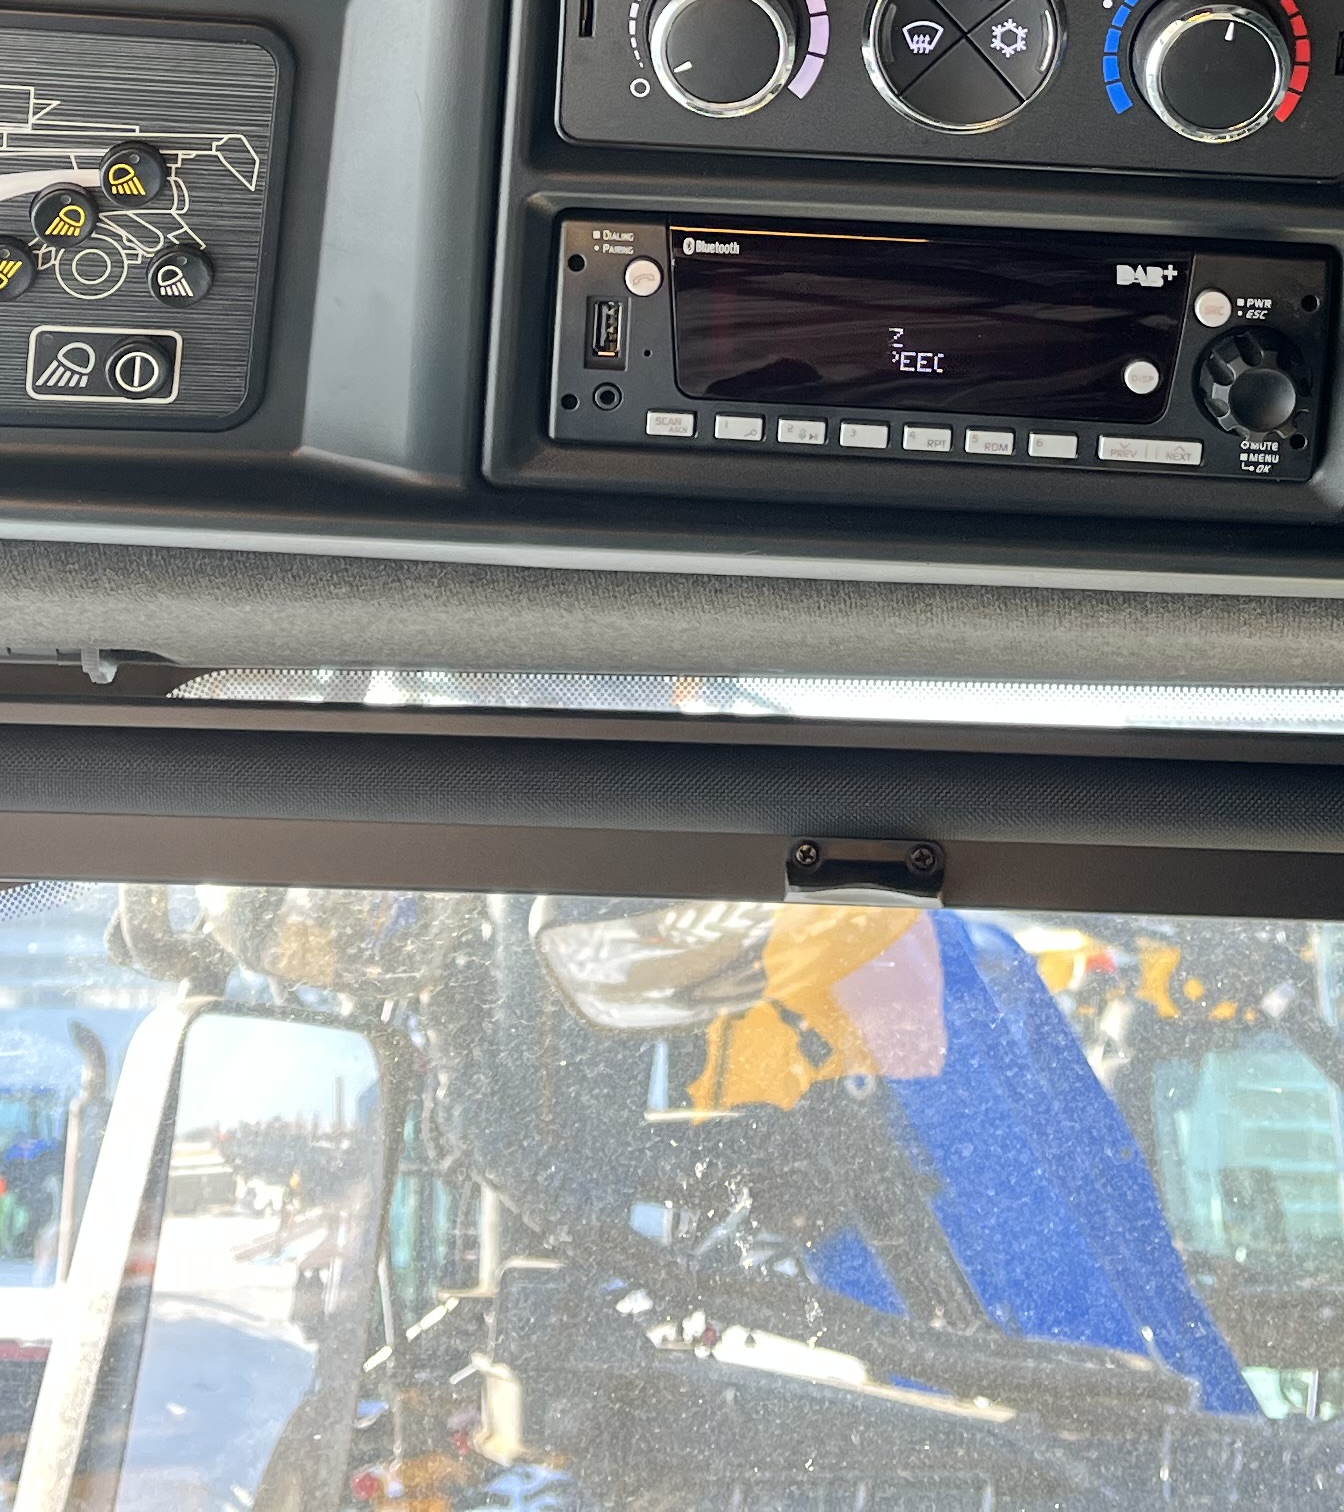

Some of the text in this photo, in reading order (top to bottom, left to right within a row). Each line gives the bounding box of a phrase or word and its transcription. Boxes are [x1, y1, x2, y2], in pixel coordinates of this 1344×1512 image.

[695, 239, 740, 254] Bluetooth
[1116, 264, 1178, 287] DAB+
[1246, 298, 1272, 309] PWR
[1204, 305, 1225, 316] SRC
[1245, 310, 1269, 320] ESC
[1131, 374, 1155, 384] DISP
[655, 416, 682, 426] SCAN
[787, 424, 794, 433] 2
[850, 428, 857, 437] 3
[909, 430, 916, 439] 4
[972, 433, 979, 443] 5
[926, 439, 947, 449] RPT
[984, 442, 1009, 452] RDM
[1036, 439, 1043, 448] 6
[1110, 448, 1138, 459] PREV
[1166, 452, 1192, 462] NEXT
[1248, 453, 1280, 464] MENU
[1255, 464, 1272, 473] OK
